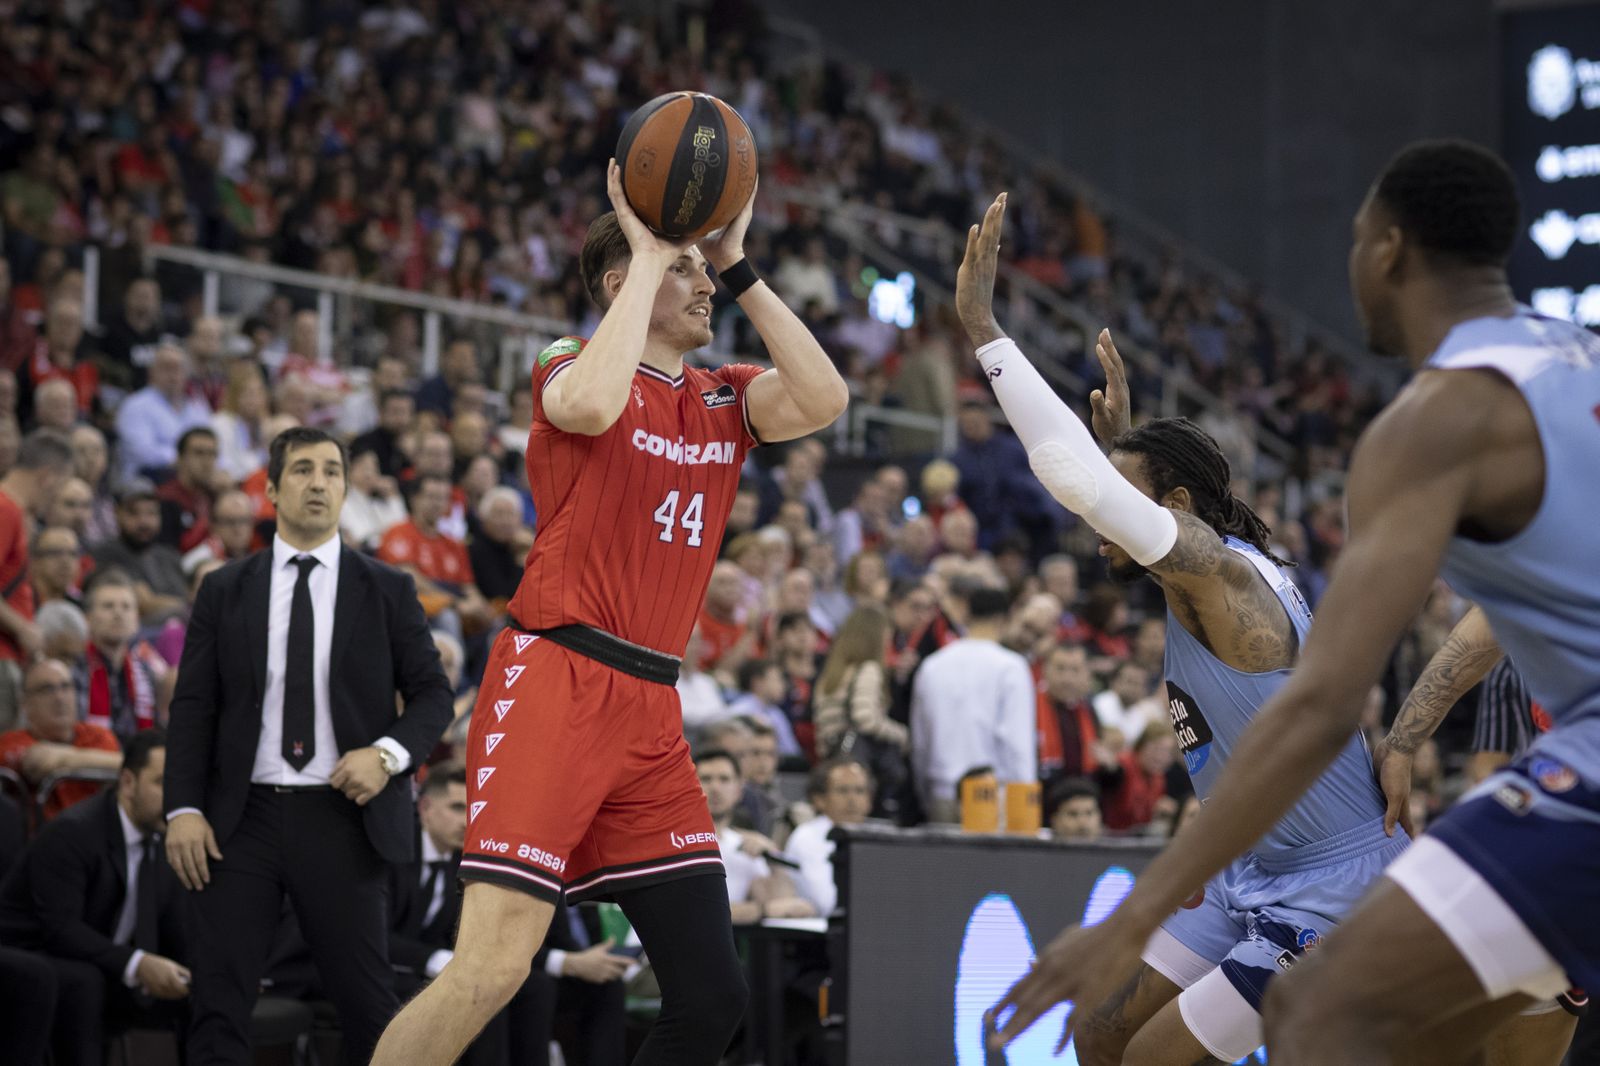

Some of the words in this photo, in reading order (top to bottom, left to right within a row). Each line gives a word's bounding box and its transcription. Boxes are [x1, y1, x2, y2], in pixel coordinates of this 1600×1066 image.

[706, 395, 736, 406] endesa
[653, 489, 705, 547] 44
[1169, 698, 1189, 725] lla
[480, 838, 510, 853] vive
[517, 843, 561, 871] asisa
